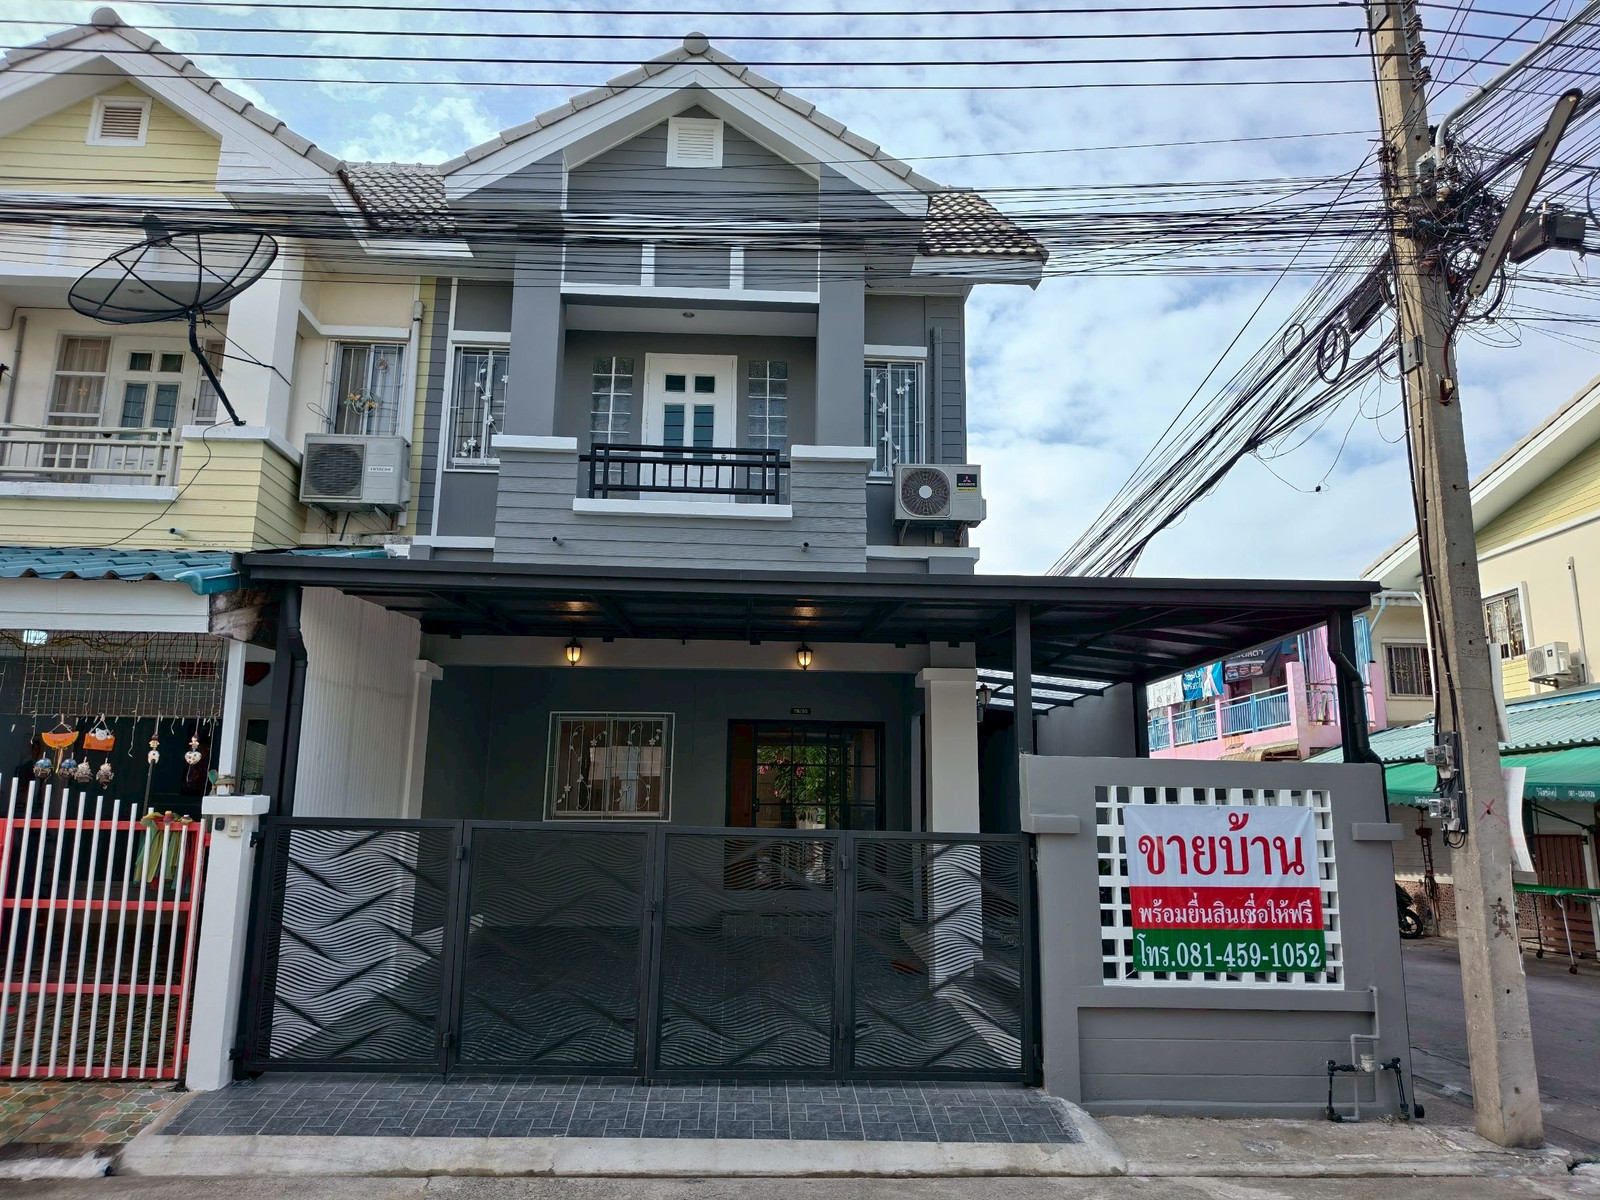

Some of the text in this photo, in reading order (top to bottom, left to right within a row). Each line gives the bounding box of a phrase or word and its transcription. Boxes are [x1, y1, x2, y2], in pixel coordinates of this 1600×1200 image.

[1138, 812, 1305, 876] ขายบ้าน
[1138, 893, 1313, 925] พร้อมยื่นสินเชื่อให้ฟรี
[1136, 933, 1322, 968] โทร.081-459-1052
